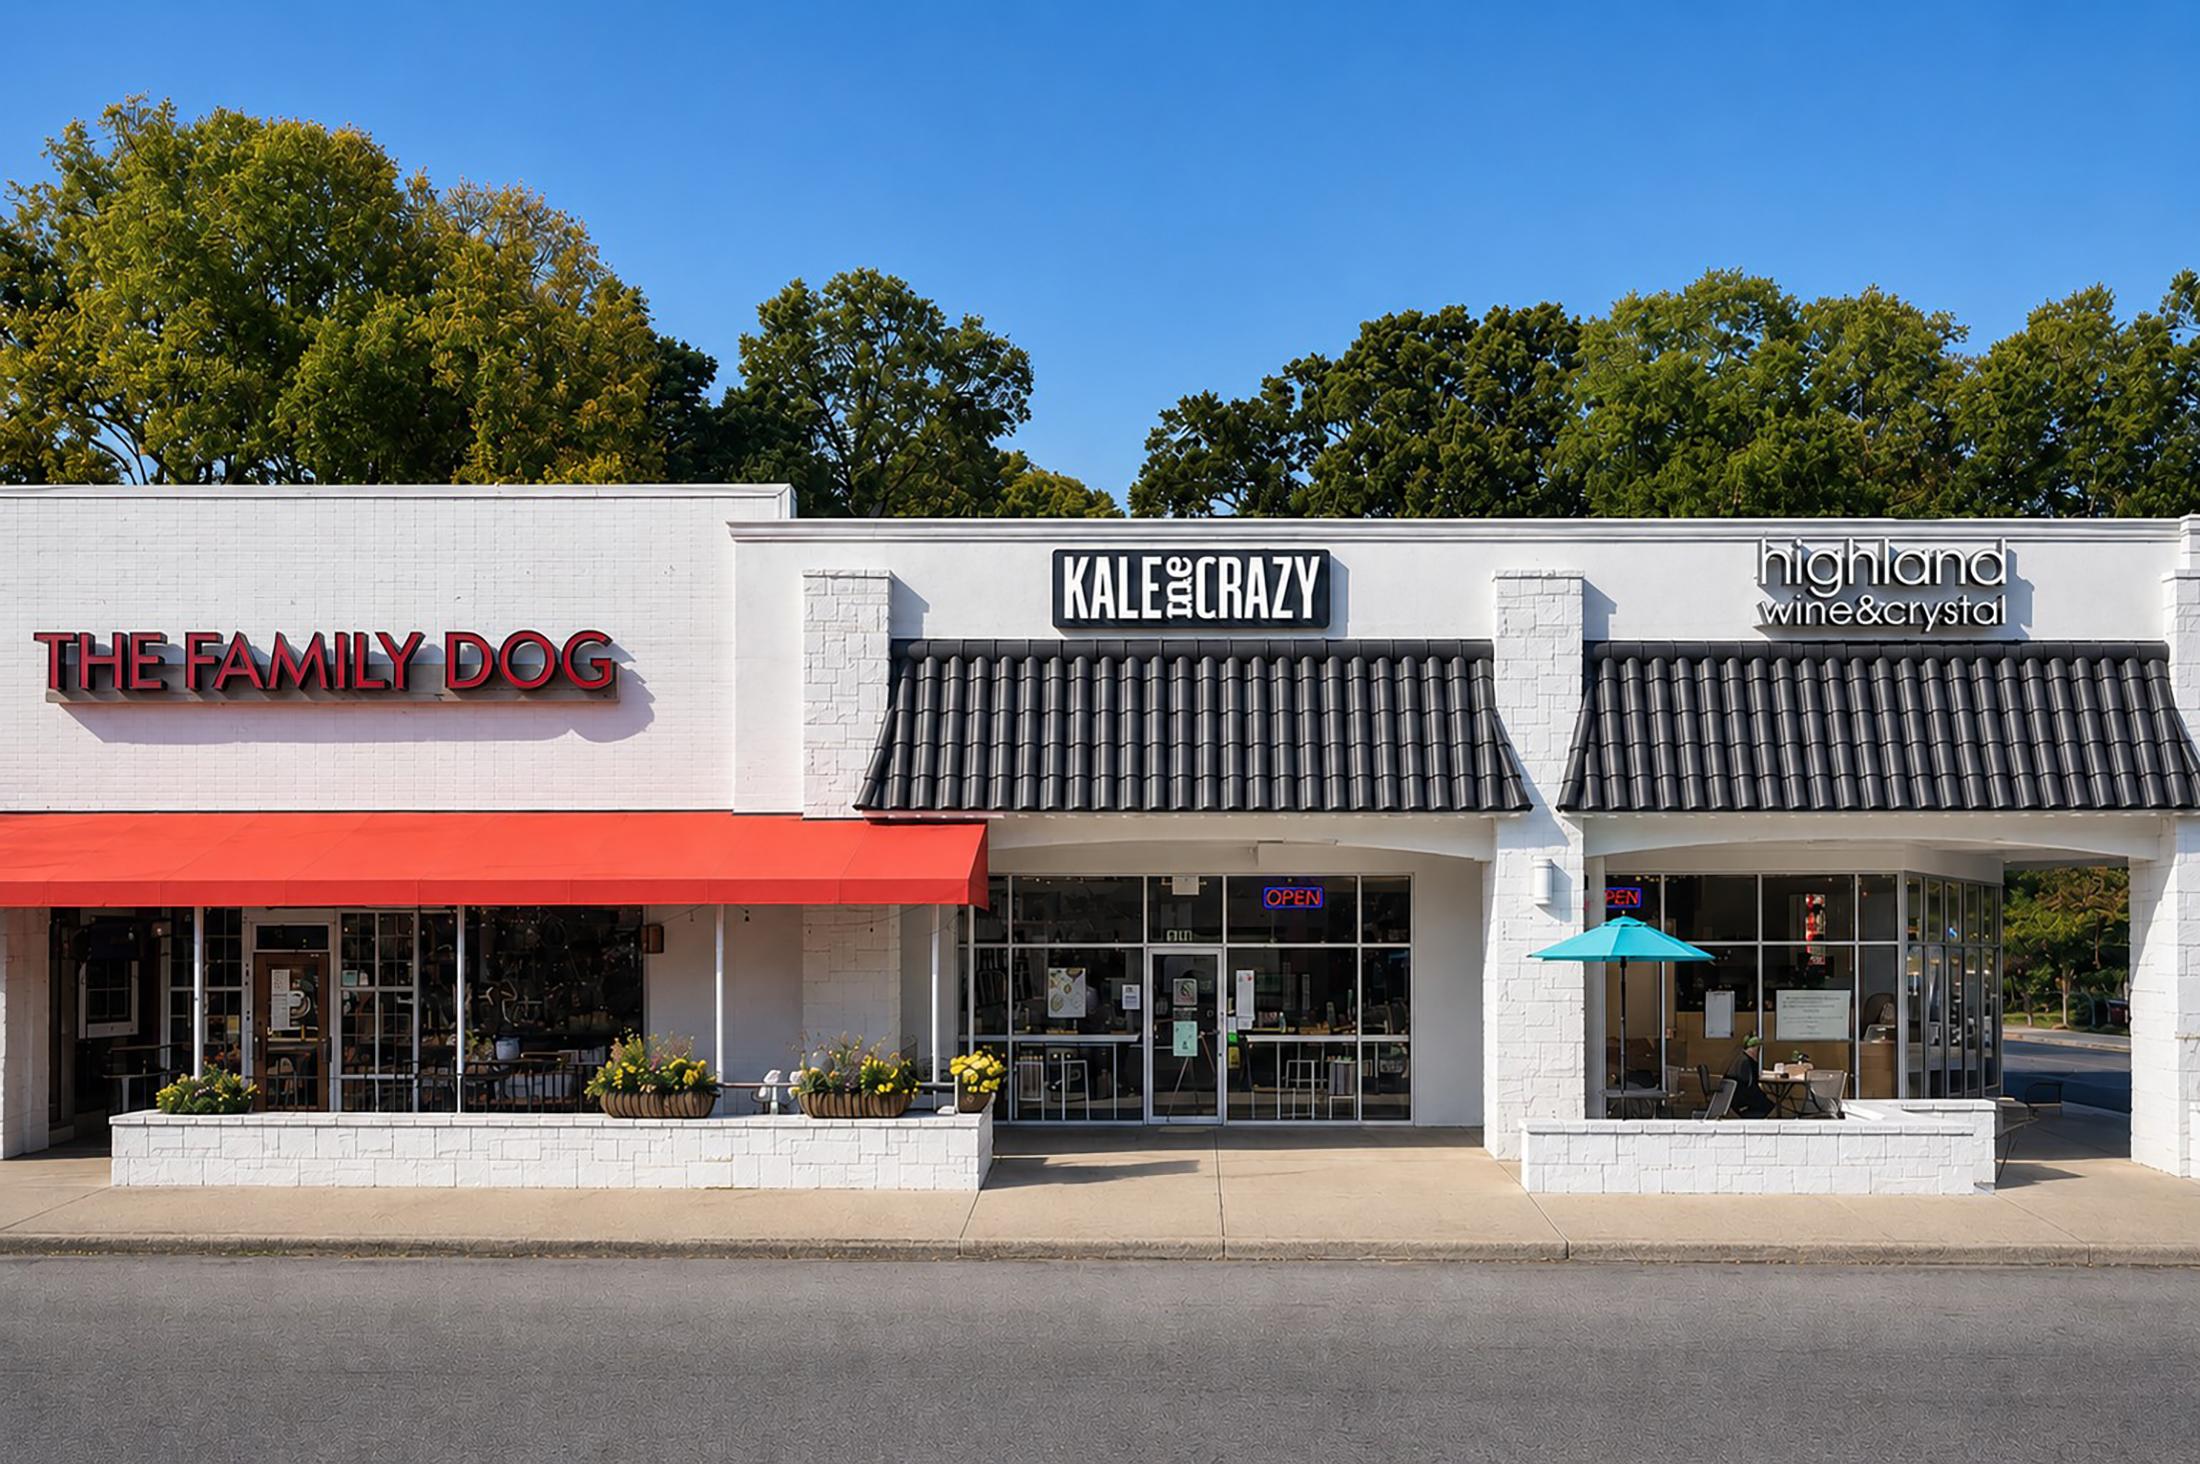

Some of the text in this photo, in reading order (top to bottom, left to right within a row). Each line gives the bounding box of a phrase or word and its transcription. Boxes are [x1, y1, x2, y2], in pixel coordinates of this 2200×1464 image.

[1063, 555, 1162, 619] KALE
[1195, 555, 1321, 620] CRAZY
[1758, 537, 2007, 598] highland
[1760, 594, 2007, 632] wine&crystal
[34, 629, 614, 691] THE FAMILY DOG
[1266, 889, 1321, 905] OPEN
[1605, 889, 1638, 905] PEN
